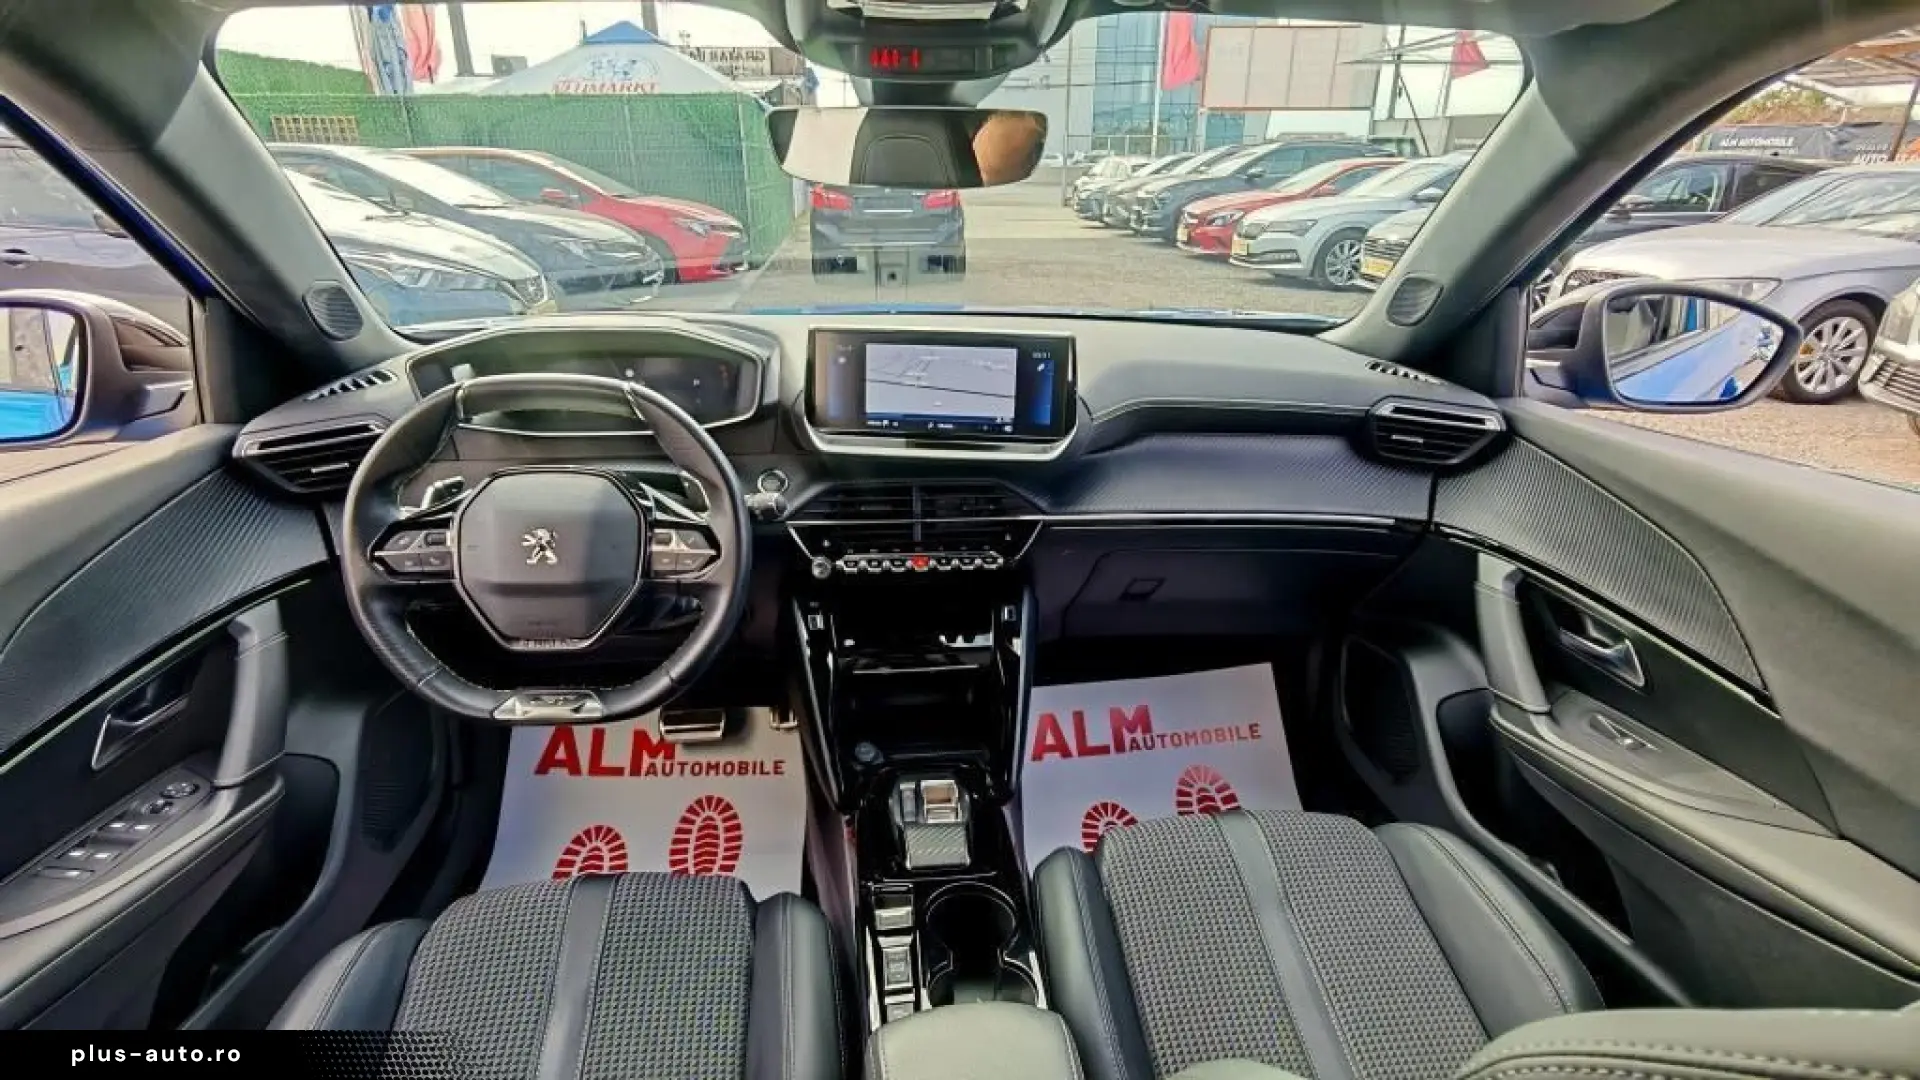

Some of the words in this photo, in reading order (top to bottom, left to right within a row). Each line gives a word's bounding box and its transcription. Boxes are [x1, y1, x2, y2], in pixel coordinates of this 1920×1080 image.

[1739, 136, 1795, 147] AUTOMOBILE
[534, 723, 676, 777] ALM
[645, 759, 786, 777] AUTOMOBILE
[1030, 704, 1153, 762] ALM
[1129, 722, 1262, 752] AUTOMOBILE
